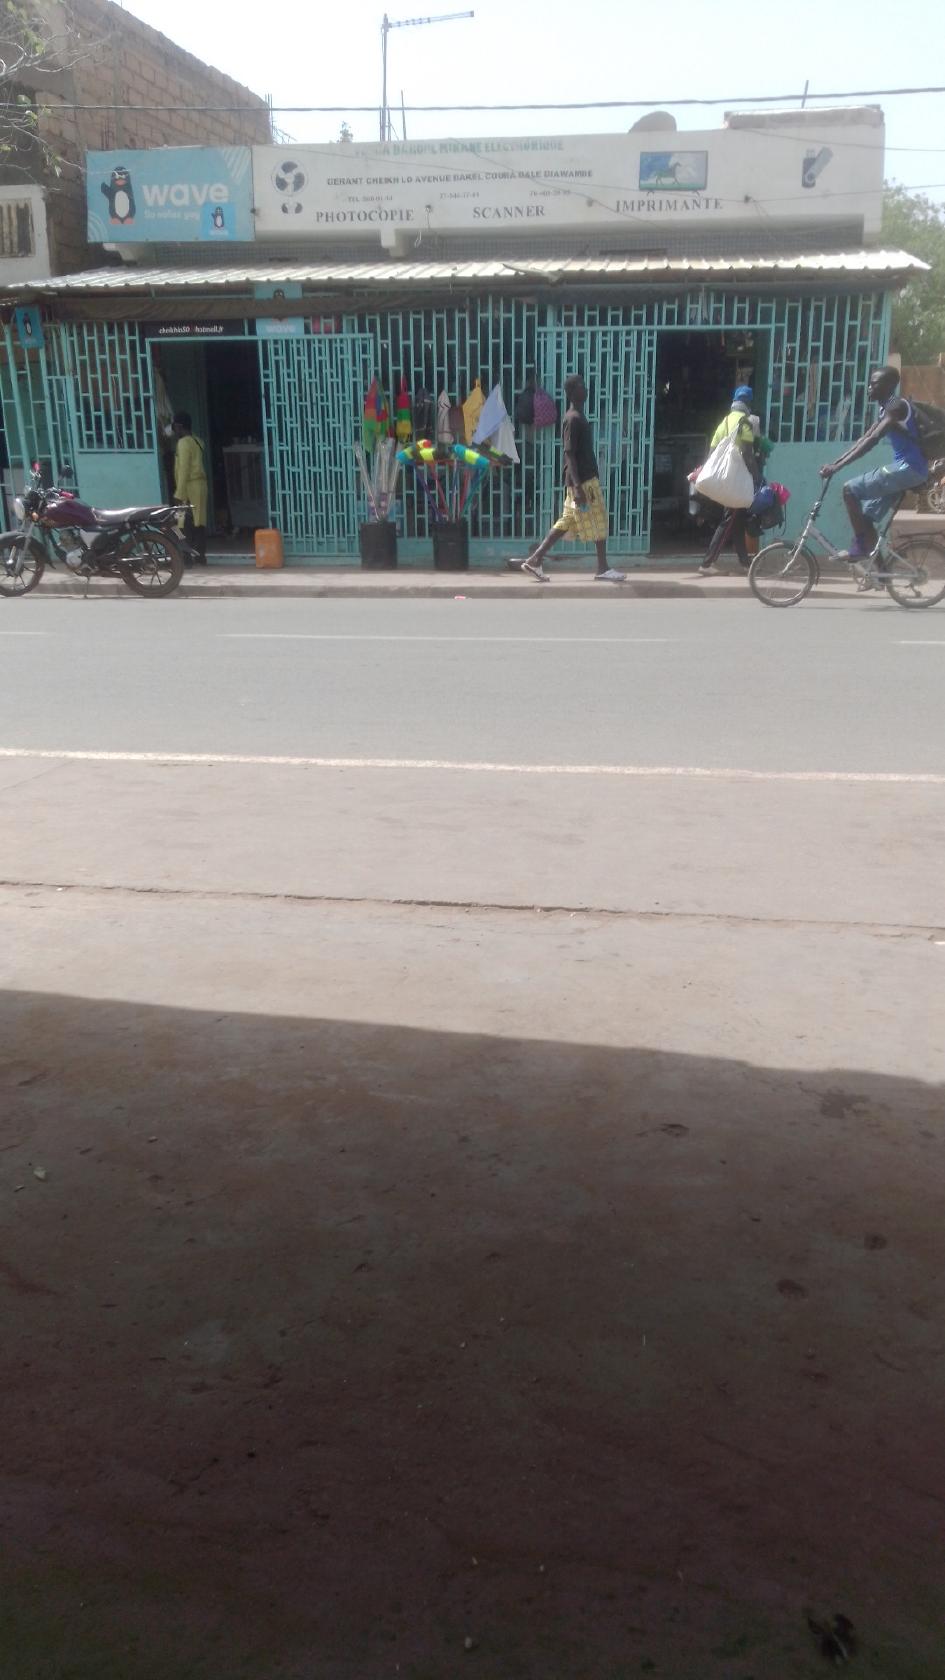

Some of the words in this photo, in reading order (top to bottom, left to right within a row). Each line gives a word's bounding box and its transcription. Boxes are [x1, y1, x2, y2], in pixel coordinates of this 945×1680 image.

[366, 175, 399, 185] CHEIKH
[415, 174, 452, 184] AVENUE
[142, 182, 229, 207] wave
[472, 205, 545, 219] SCANNER
[616, 197, 723, 213] IMPRIMANTE
[316, 209, 414, 223] PHOTOCOPIE
